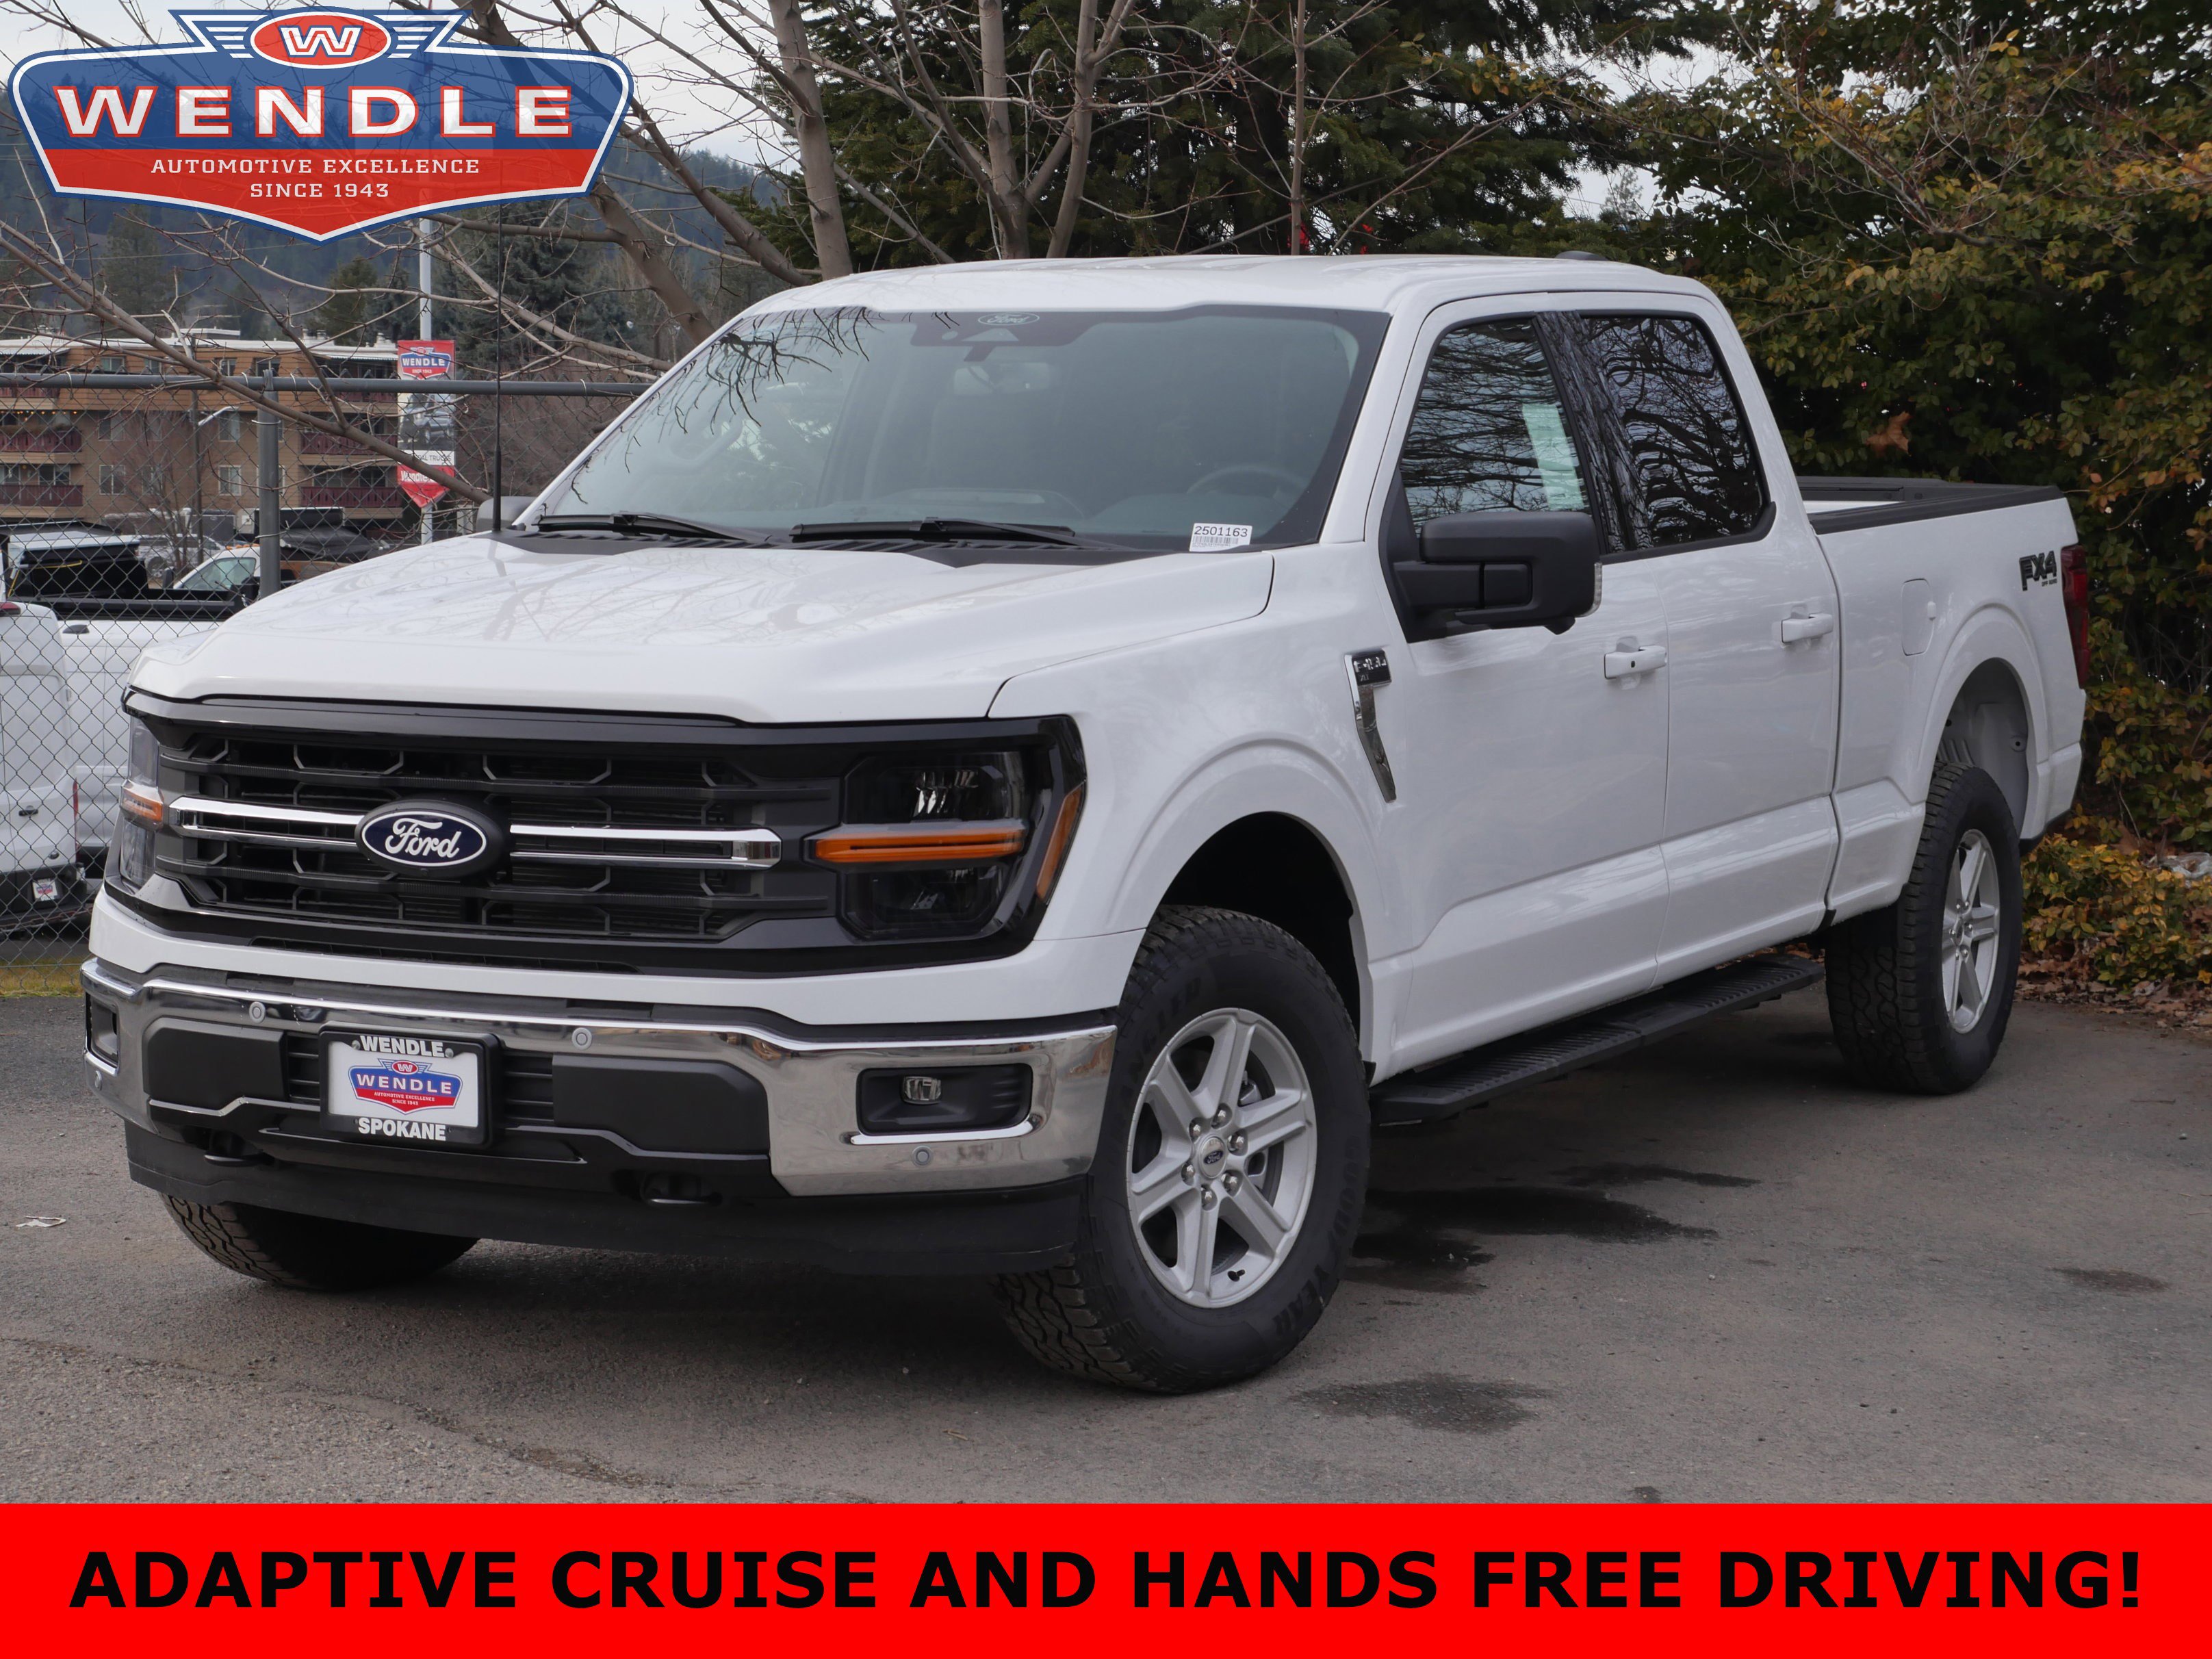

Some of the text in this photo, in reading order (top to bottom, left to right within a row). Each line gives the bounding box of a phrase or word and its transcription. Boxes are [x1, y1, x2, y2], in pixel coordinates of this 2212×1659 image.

[988, 313, 1029, 323] Ford
[402, 358, 446, 366] WENDLE
[1194, 526, 1248, 537] 2501163
[2019, 550, 2057, 591] FX4
[385, 818, 461, 858] Ford
[360, 1036, 444, 1057] WENDLE
[357, 1074, 452, 1094] WENDLE
[358, 1118, 446, 1142] SPOKANE
[1207, 1150, 1221, 1163] Ford
